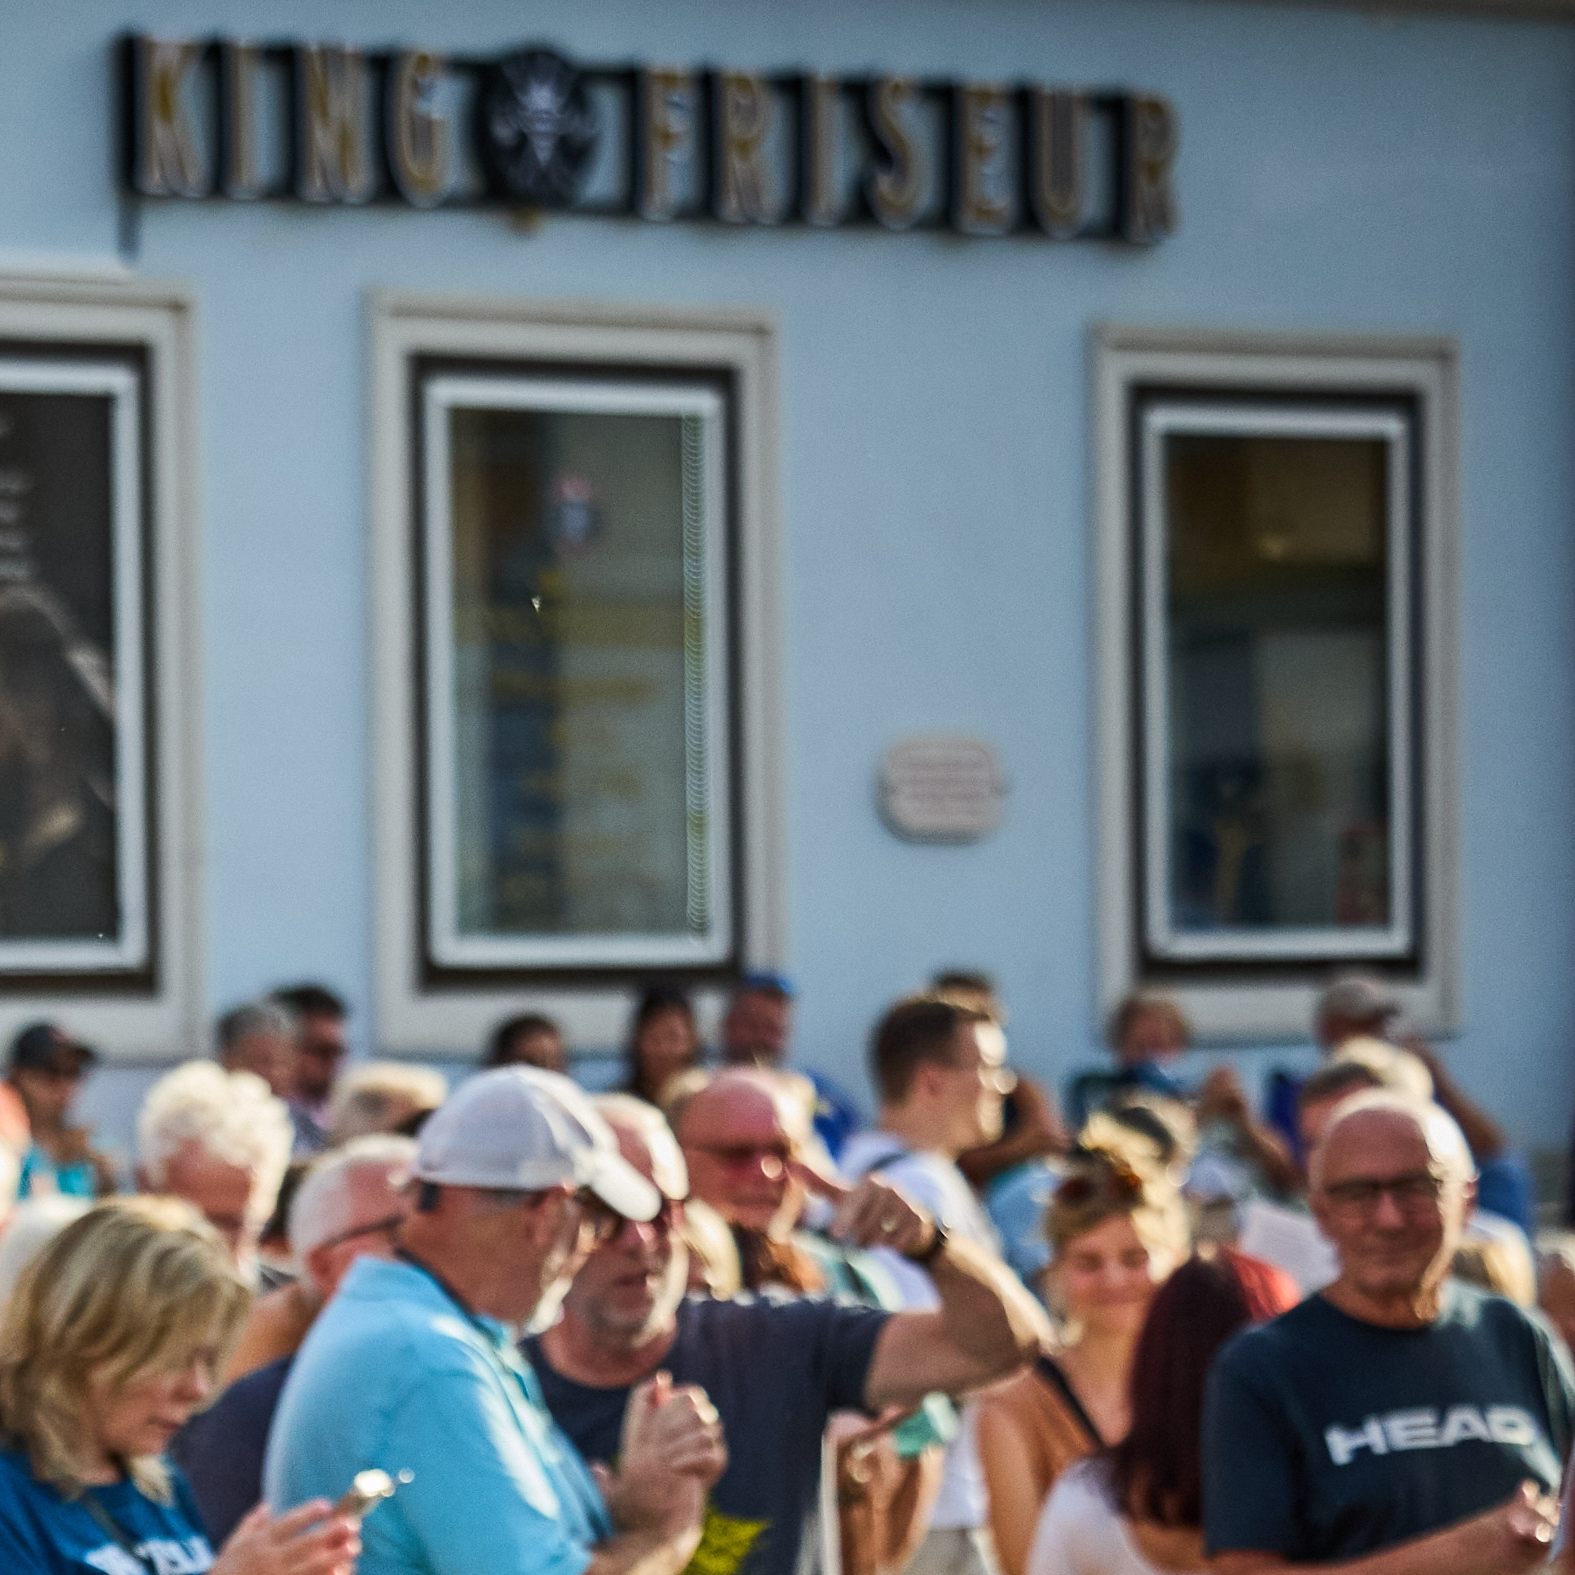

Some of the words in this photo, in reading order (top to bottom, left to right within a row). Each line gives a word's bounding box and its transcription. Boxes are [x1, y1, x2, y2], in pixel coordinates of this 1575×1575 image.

[125, 36, 455, 208] KING
[637, 64, 1179, 245] FRISEUR
[1324, 1405, 1539, 1466] HEAD
